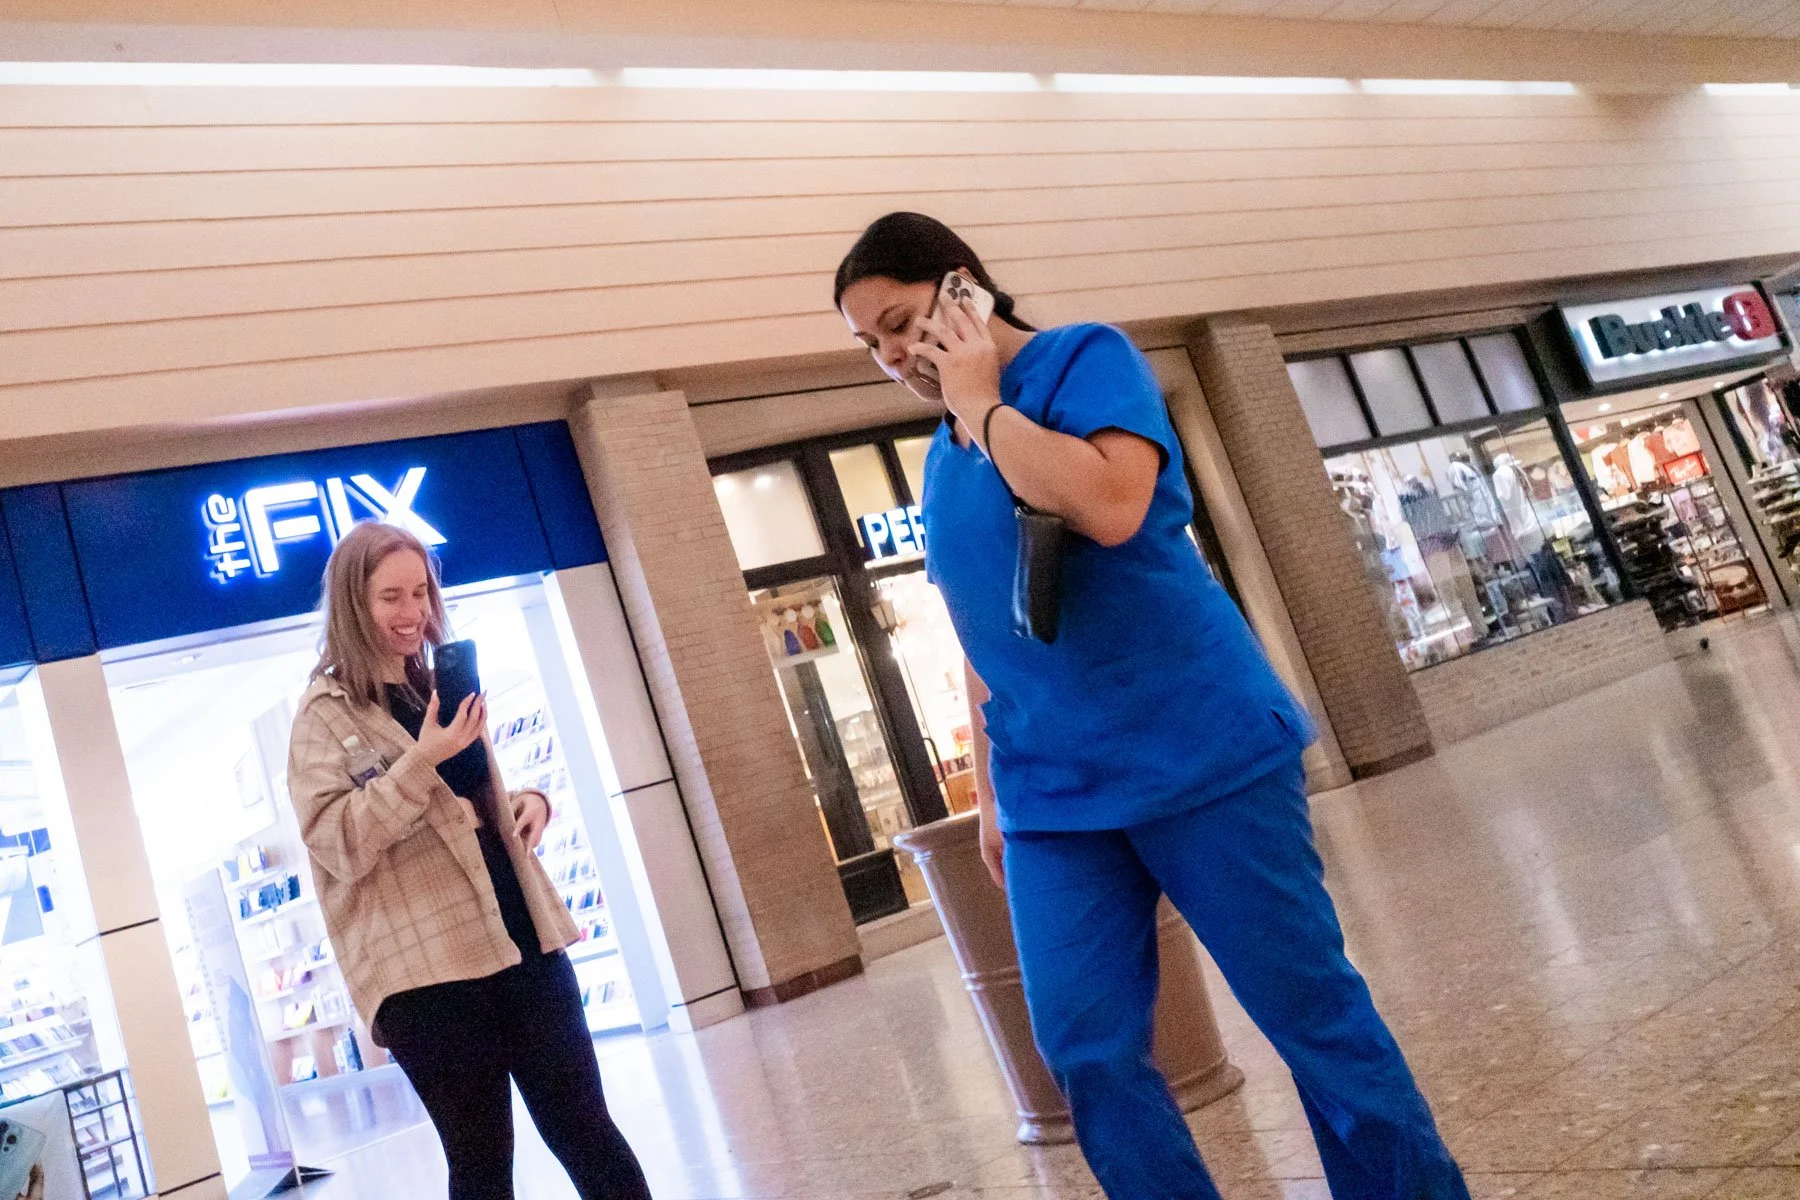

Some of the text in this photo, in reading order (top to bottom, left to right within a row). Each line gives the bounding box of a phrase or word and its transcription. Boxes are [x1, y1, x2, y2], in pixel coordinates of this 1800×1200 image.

[1588, 301, 1735, 359] Buckle
[205, 466, 448, 578] the FIX
